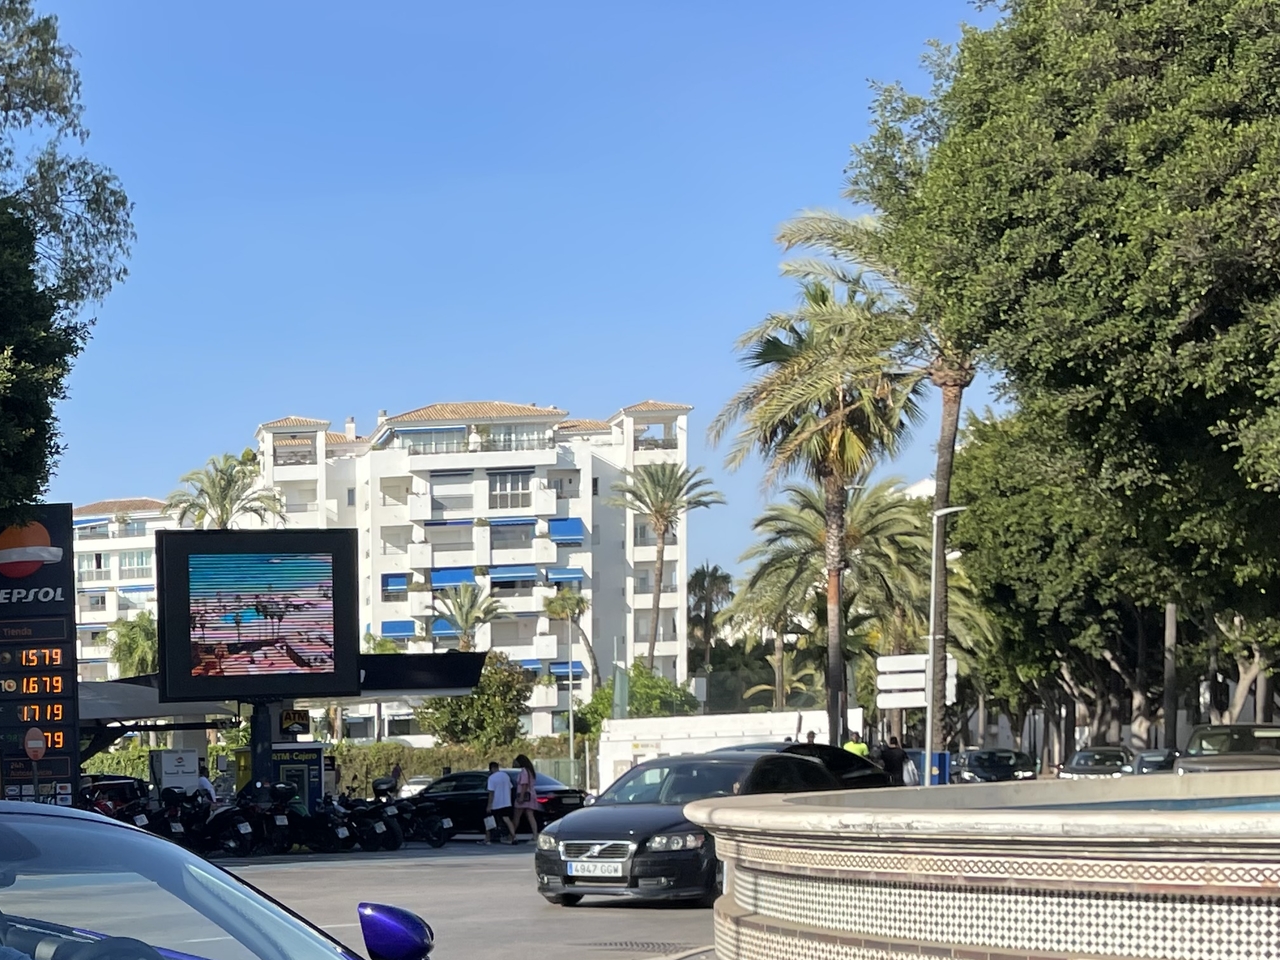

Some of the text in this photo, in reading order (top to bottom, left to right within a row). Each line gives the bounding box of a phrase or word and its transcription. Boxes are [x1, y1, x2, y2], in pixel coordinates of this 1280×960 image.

[2, 627, 32, 636] Tienda
[284, 712, 308, 722] ATM
[574, 864, 597, 874] 4947
